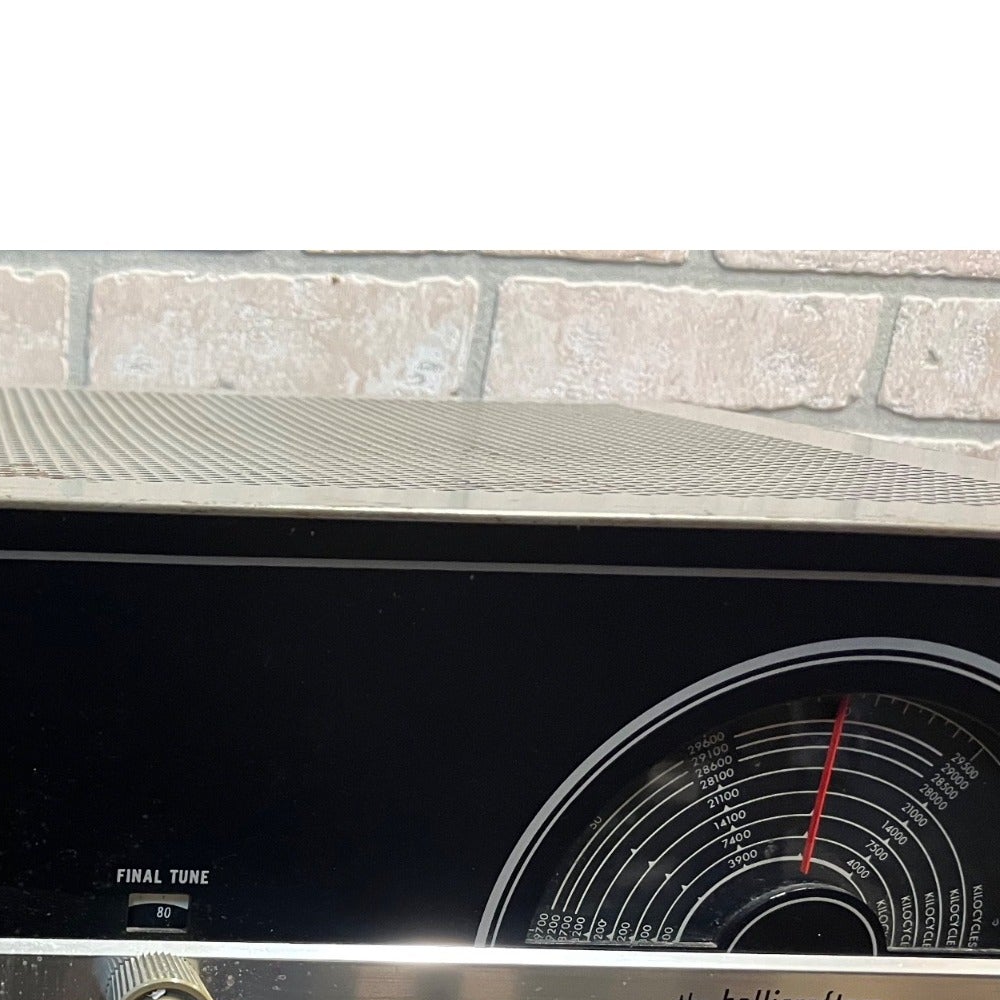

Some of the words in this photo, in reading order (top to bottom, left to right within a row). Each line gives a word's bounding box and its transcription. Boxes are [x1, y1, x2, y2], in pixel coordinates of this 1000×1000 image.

[687, 731, 725, 755] 29600
[691, 743, 729, 767] 29100
[695, 755, 733, 778] 28600
[940, 762, 969, 790] 29000
[950, 752, 979, 780] 29500
[699, 768, 735, 790] 28100
[930, 773, 959, 800] 28500
[706, 788, 740, 809] 21100
[919, 783, 948, 810] 28000
[713, 809, 746, 831] 14100
[901, 802, 928, 827] 21000
[721, 829, 751, 849] 7400
[881, 820, 908, 845] 14000
[727, 849, 758, 869] 3900
[865, 839, 889, 861] 7500
[116, 868, 162, 884] FINAL
[169, 869, 210, 885] TUNE
[846, 859, 870, 879] 4000
[156, 906, 171, 919] 80
[900, 895, 913, 946] KILOCYCL
[921, 892, 935, 948] KILOCYCLE
[946, 888, 960, 946] KILOCYCLE
[967, 884, 983, 948] KILOCYCLES
[534, 913, 549, 940] 9700
[545, 914, 561, 941] 9200
[557, 915, 573, 941] 8700
[571, 916, 586, 941] 200
[593, 919, 608, 940] 200
[616, 922, 631, 942] 200
